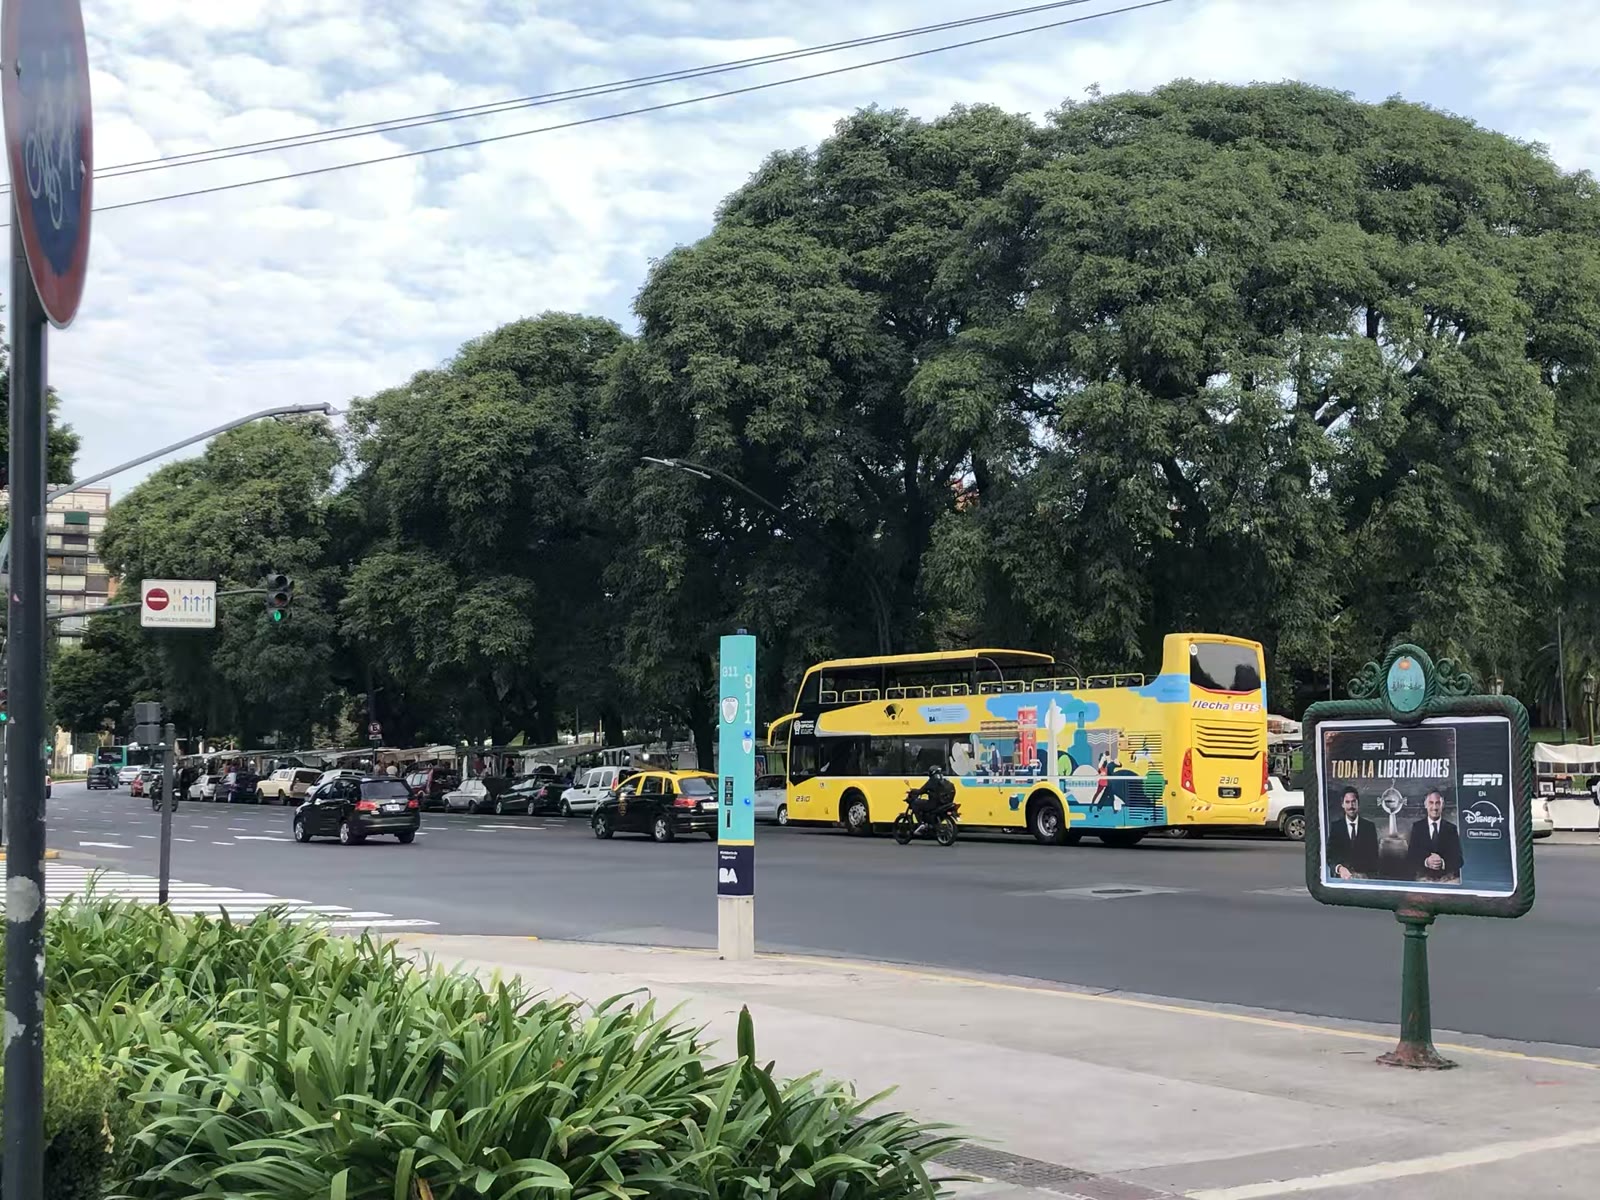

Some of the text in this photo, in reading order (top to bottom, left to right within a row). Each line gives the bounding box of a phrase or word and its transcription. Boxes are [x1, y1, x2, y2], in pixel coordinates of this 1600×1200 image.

[722, 666, 738, 677] 911
[1232, 702, 1261, 712] BUS
[1362, 742, 1384, 750] ESPN
[1332, 758, 1450, 778] TODA LA LIBERTADORES
[1219, 776, 1239, 784] 2310
[1462, 773, 1503, 786] ESPN
[719, 867, 738, 884] BA
